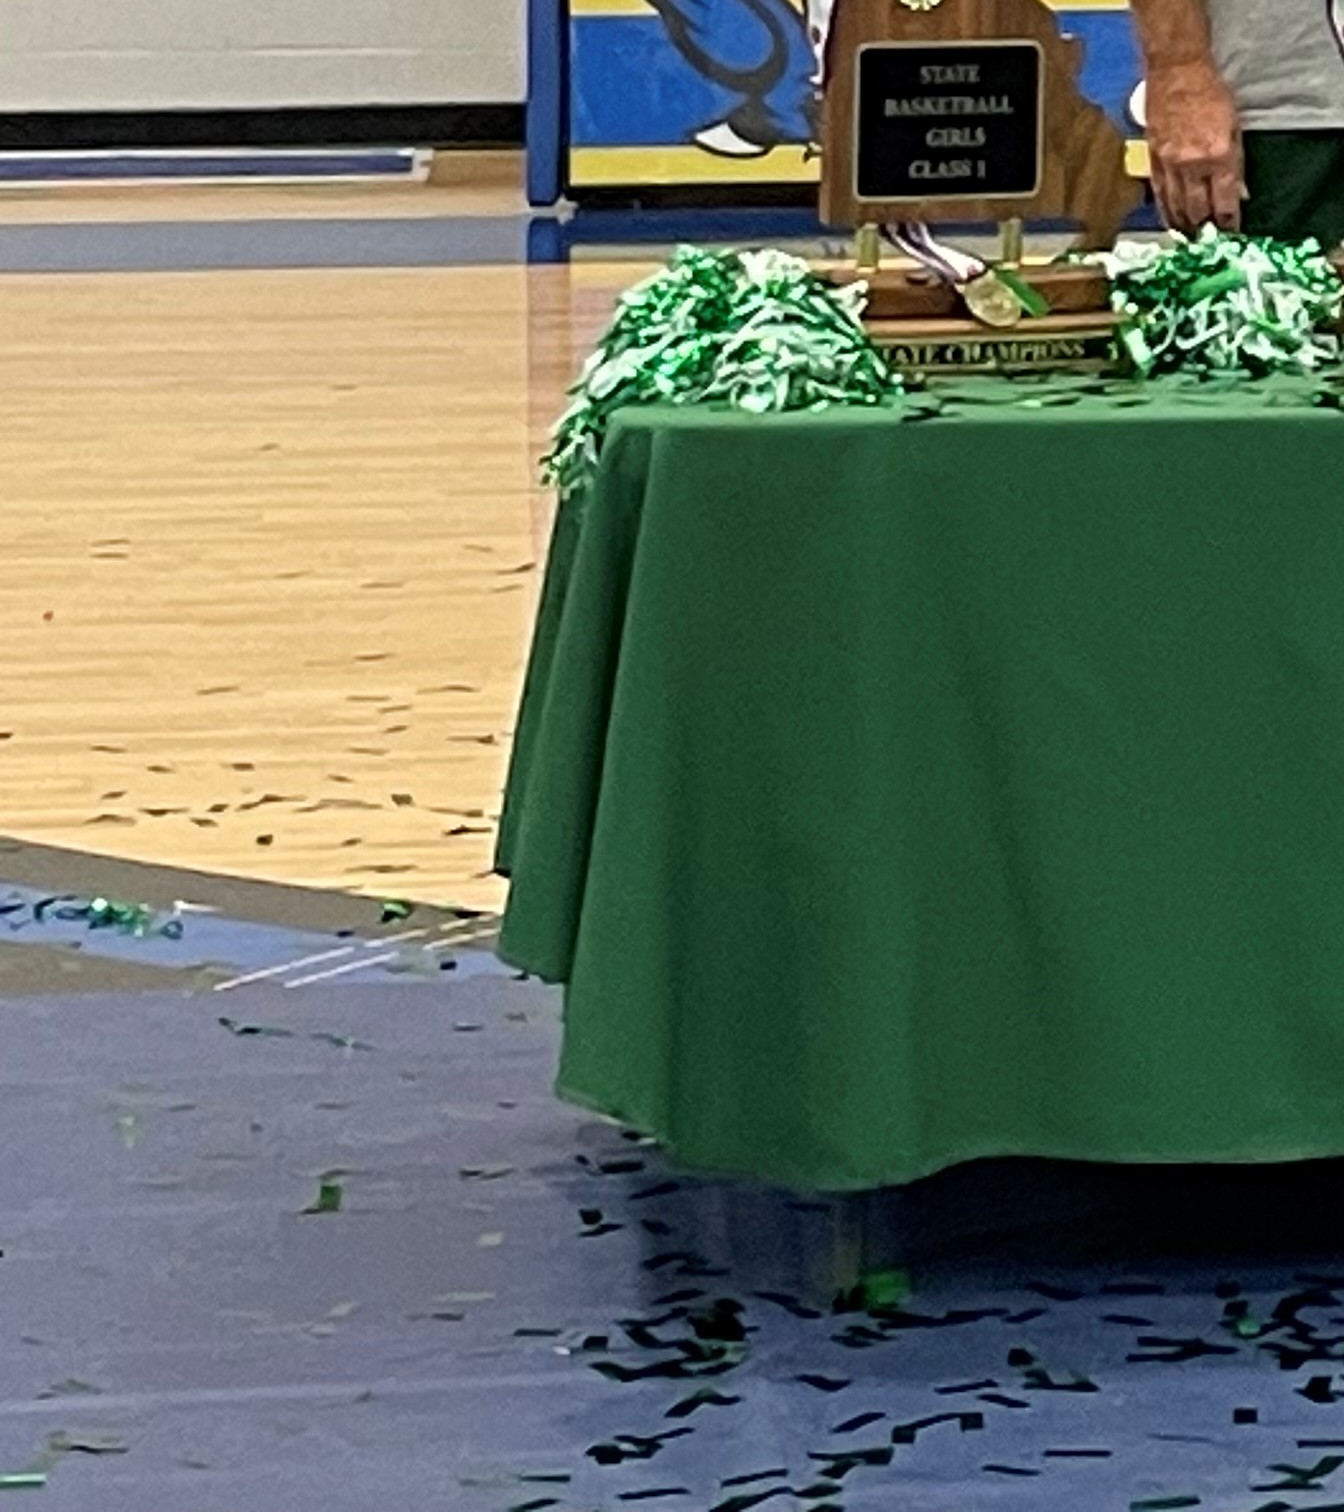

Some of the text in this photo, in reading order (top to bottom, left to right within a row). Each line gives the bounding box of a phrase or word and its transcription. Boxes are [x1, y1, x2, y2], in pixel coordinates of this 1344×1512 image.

[919, 64, 981, 85] STATE
[884, 95, 1014, 118] BASKETBALL
[925, 126, 986, 147] GIRLS
[908, 159, 972, 179] CLASS
[881, 342, 939, 365] TATE
